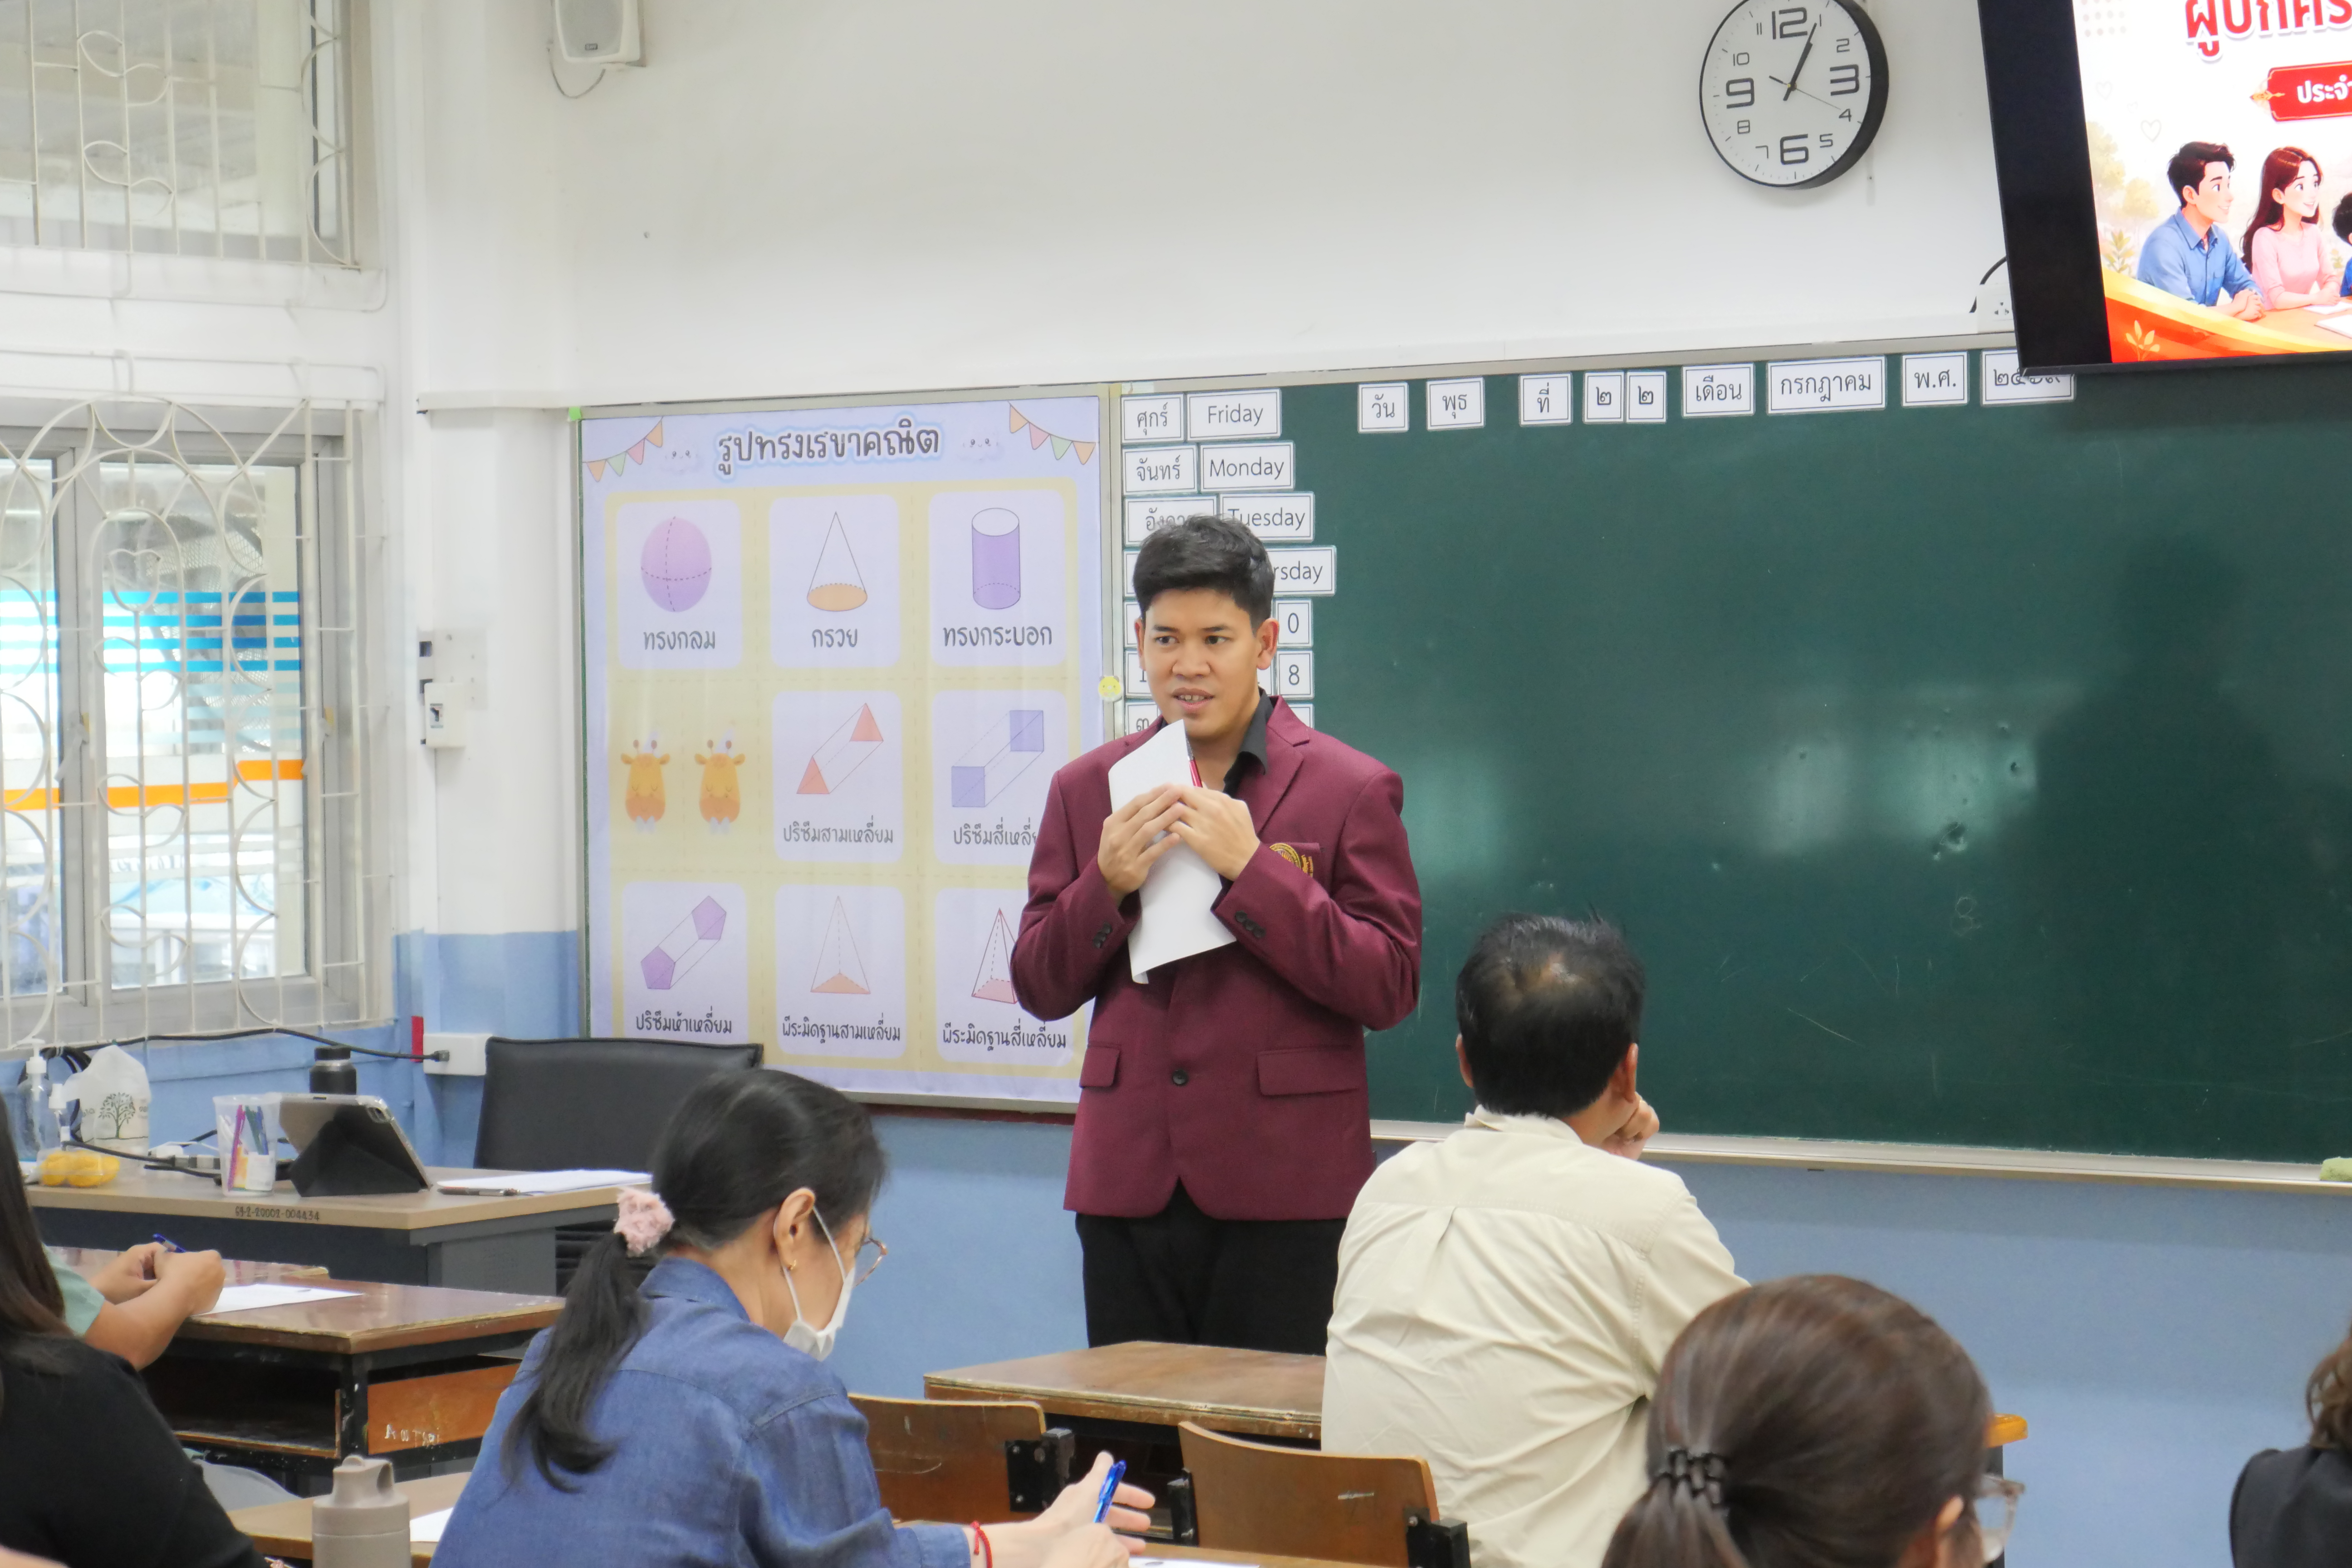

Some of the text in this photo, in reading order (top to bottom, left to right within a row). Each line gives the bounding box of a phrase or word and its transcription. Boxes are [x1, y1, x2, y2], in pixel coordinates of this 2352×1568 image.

[1771, 7, 1808, 40] 12
[1836, 38, 1850, 53] 2
[1733, 52, 1750, 66] 10
[1829, 64, 1860, 96] 3
[1725, 78, 1755, 109] 9
[1737, 119, 1751, 135] 8
[1838, 108, 1852, 122] 4
[1755, 145, 1769, 159] 7
[1779, 133, 1809, 165] 6
[1819, 133, 1833, 148] 5
[1372, 393, 1395, 418] วัน
[1442, 394, 1467, 419] พุธ
[1537, 382, 1549, 413] ที่
[1596, 387, 1612, 406] ๒
[1637, 386, 1654, 405] ๒
[1696, 375, 1742, 402] เดือน
[1781, 371, 1872, 401] กรกฎาคม
[1914, 369, 1956, 389] พ.ศ.
[1137, 402, 1168, 436] ศุกร์
[1208, 403, 1264, 426] Friday
[717, 418, 939, 475] รูปทรงเรขาคณิต
[1136, 455, 1181, 481] จันทร์
[1210, 456, 1284, 480] Monday
[1227, 507, 1305, 531] Tuesday
[1273, 560, 1323, 584] rsday
[1288, 612, 1299, 634] 0
[643, 630, 715, 650] ทรงกลม
[812, 628, 858, 648] กรวย
[943, 626, 1052, 647] ทรงกระบอก
[1289, 664, 1300, 686] 8
[783, 815, 893, 843] ปริซึมสามเหลี่ยม
[636, 1006, 732, 1034] ปริซึมห้าเหลี่ยม
[782, 1013, 901, 1044] พีระมิดฐานสามเหลี่ยม
